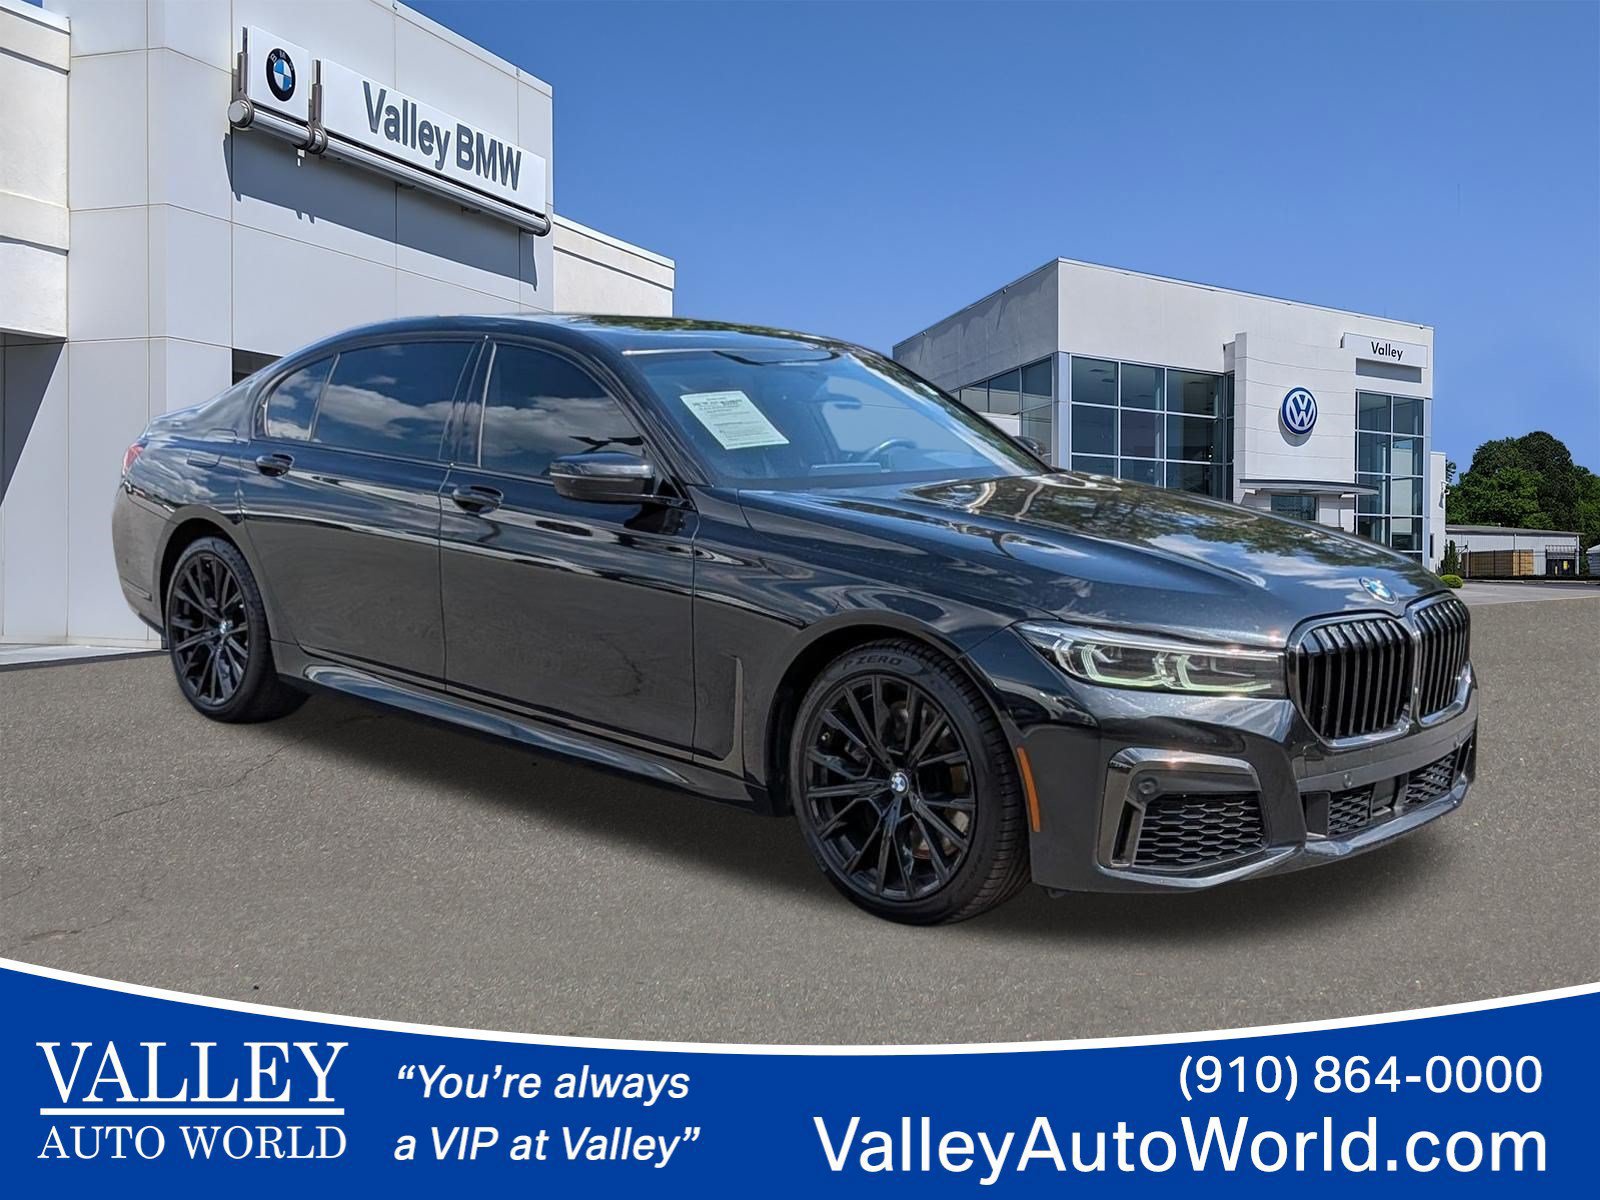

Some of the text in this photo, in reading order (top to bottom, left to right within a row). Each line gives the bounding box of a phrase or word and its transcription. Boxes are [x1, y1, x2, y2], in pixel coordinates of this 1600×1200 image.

[362, 80, 522, 191] Valley BMW
[1371, 341, 1404, 361] Valley
[855, 654, 903, 666] ZERO
